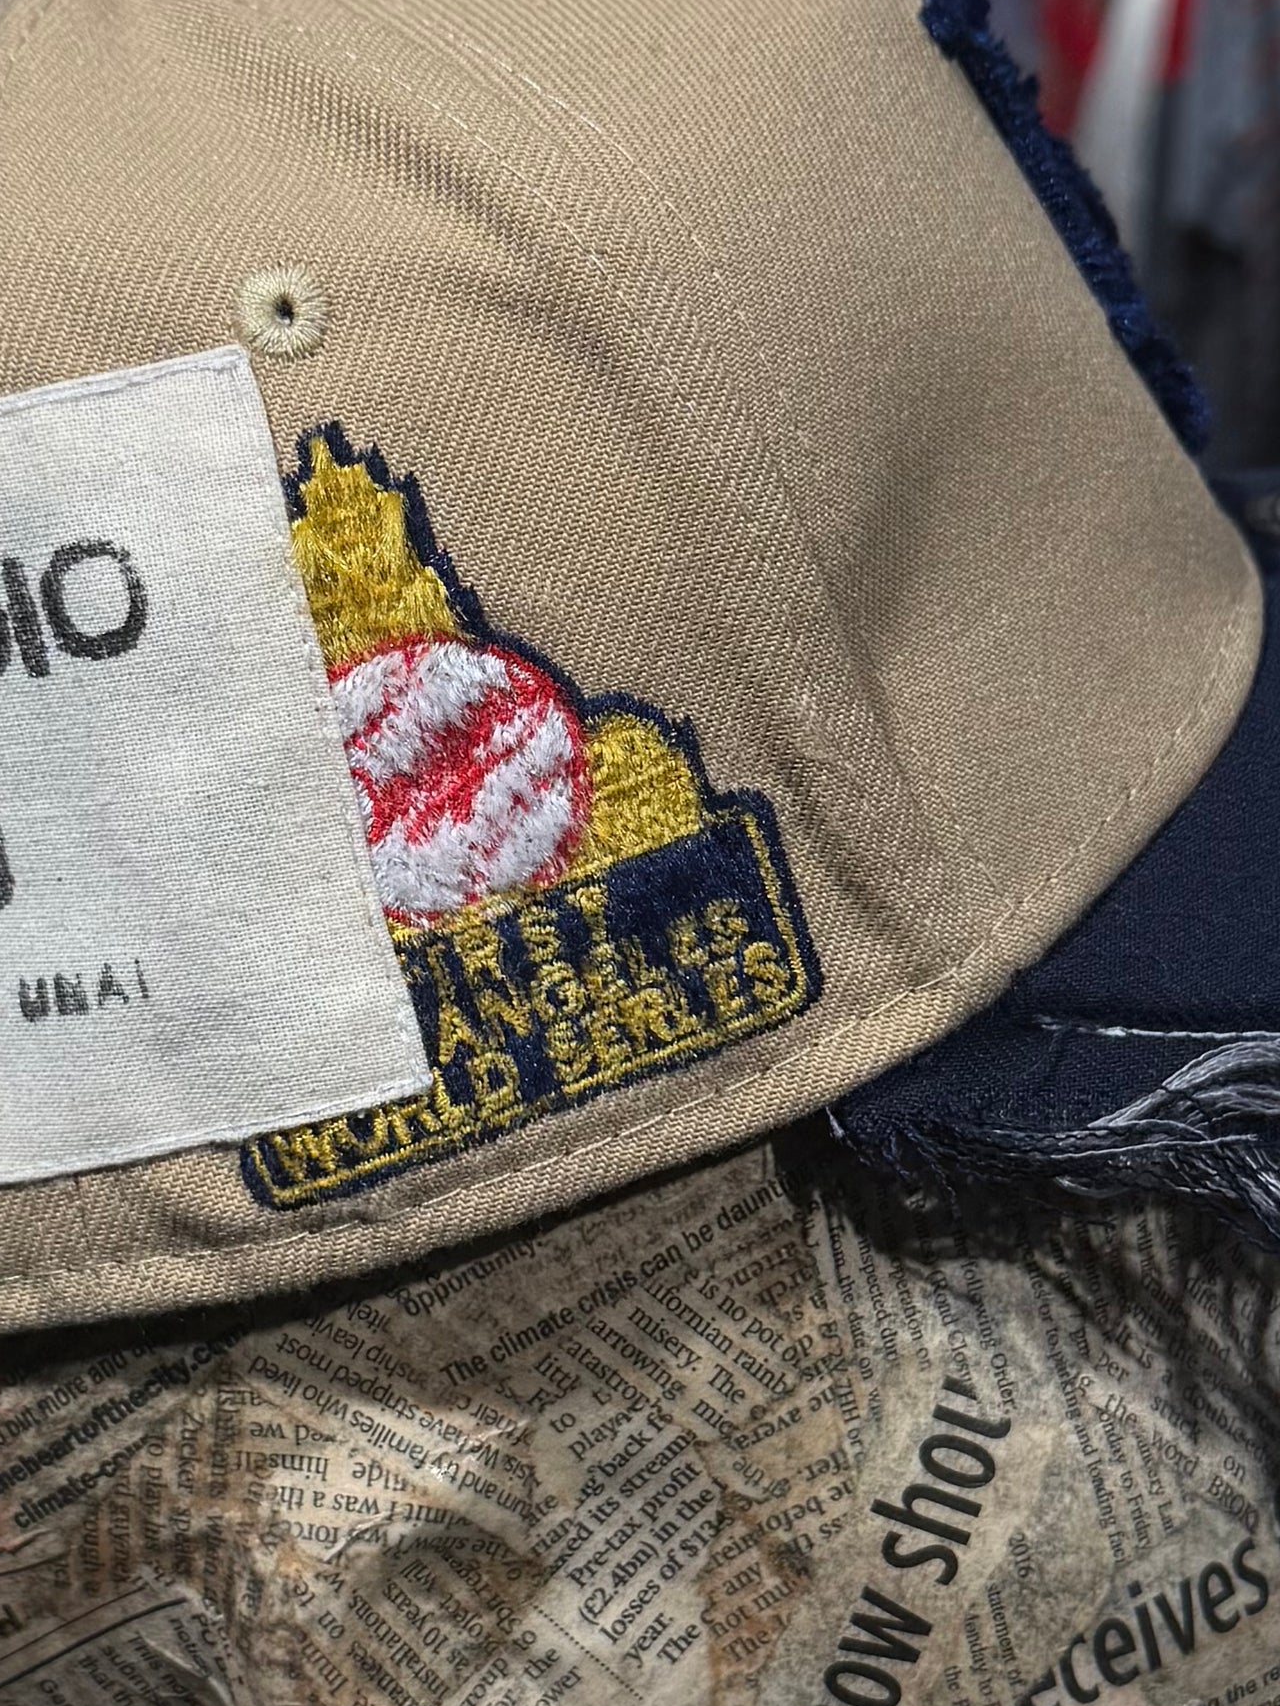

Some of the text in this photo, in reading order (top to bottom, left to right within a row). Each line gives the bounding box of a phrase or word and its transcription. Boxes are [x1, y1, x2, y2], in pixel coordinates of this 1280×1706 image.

[439, 1222, 715, 1387] The climate crisis can be
[697, 1276, 783, 1353] is no pot
[827, 1223, 874, 1380] from the date on
[961, 1257, 1003, 1349] following
[36, 1376, 87, 1418] more
[87, 1344, 128, 1385] and
[275, 1332, 421, 1421] stripped most
[626, 1305, 747, 1404] misery. The
[916, 1347, 933, 1371] on
[175, 1407, 204, 1496] Zucker
[246, 1353, 498, 1500] and families who lived
[1073, 1422, 1098, 1456] and
[1104, 1392, 1200, 1478] the word
[140, 1465, 167, 1510] play
[313, 1491, 379, 1514] was a
[1223, 1455, 1247, 1483] on
[566, 1460, 702, 1590] Pre-tax profit
[587, 1495, 621, 1526] its
[399, 1558, 437, 1593] will
[576, 1488, 714, 1627] (£2.4bn) in the
[722, 1561, 763, 1597] any
[317, 1610, 345, 1639] on
[380, 1575, 470, 1671] as 10 years.
[597, 1548, 685, 1646] losses of
[986, 1584, 1016, 1664] statement
[523, 1647, 560, 1681] the
[620, 1610, 676, 1670] year.
[655, 1622, 701, 1666] The
[943, 1666, 960, 1690] the
[1226, 1679, 1257, 1704] the
